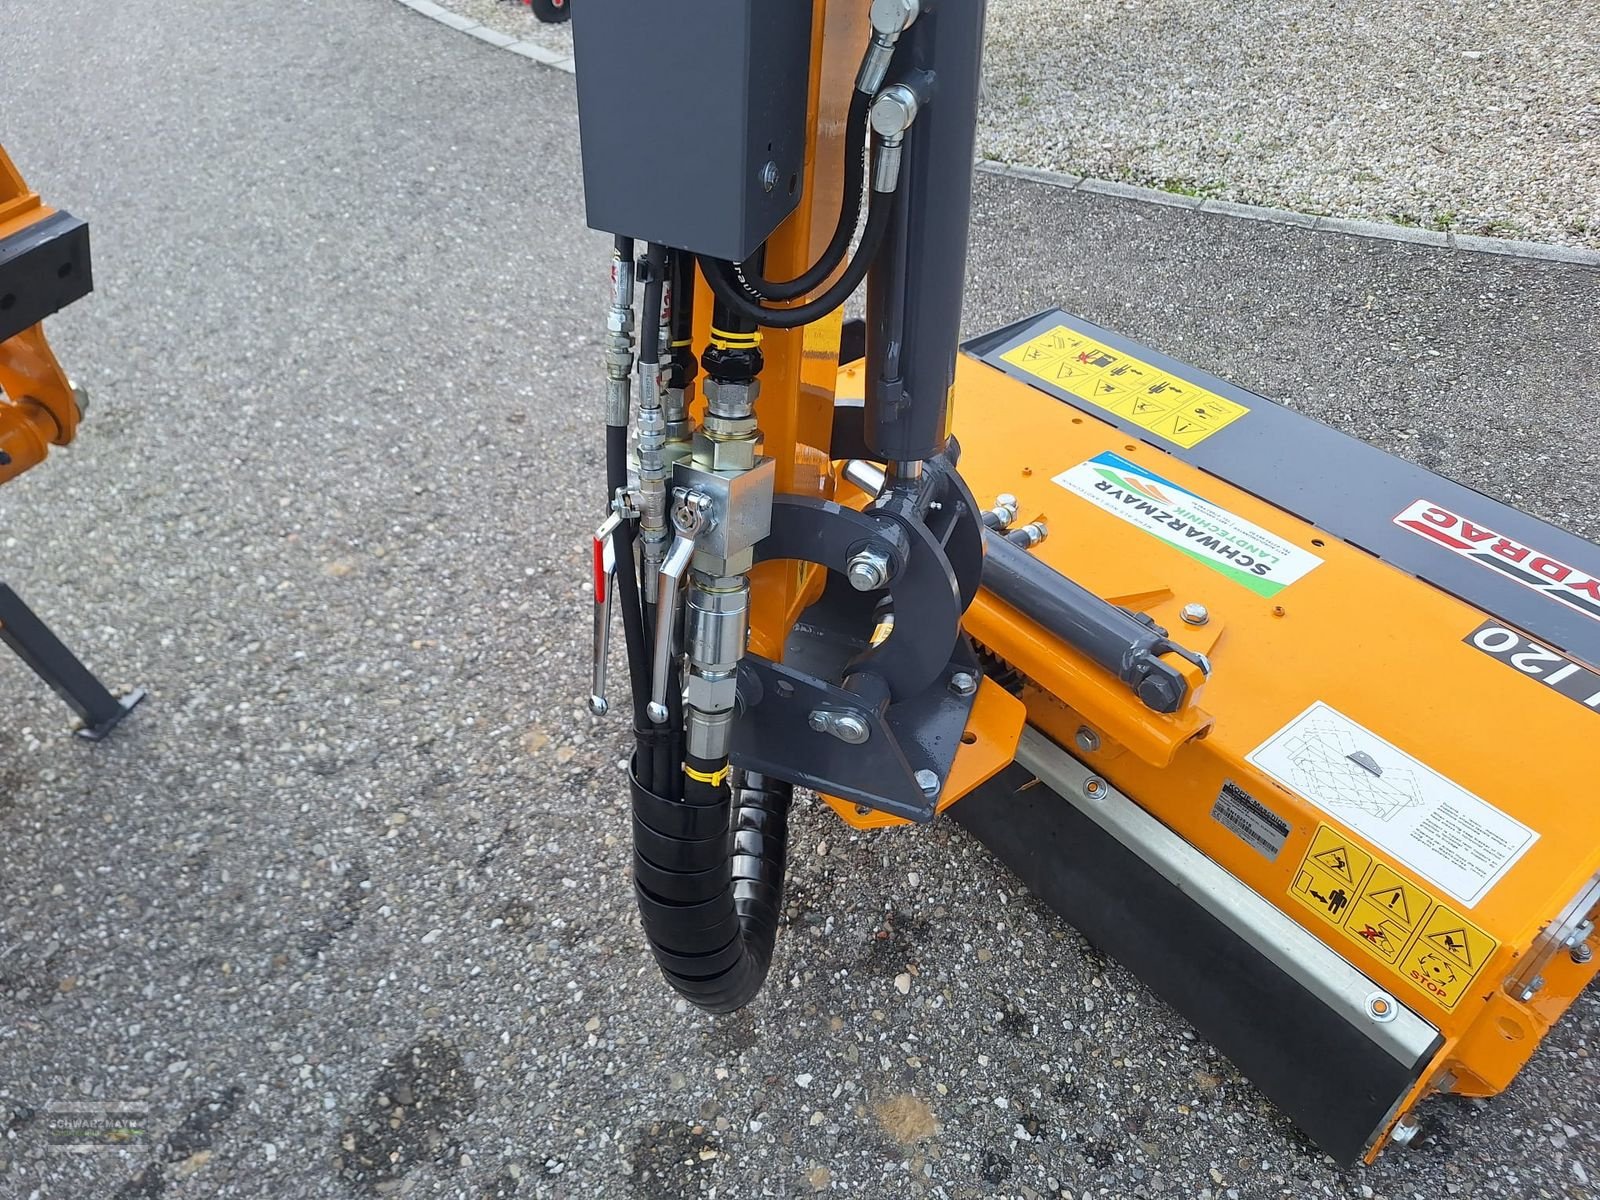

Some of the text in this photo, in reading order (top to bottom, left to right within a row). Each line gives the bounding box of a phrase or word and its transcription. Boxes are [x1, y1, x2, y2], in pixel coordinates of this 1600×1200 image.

[1094, 480, 1272, 577] SCHWARZMAYR
[1172, 507, 1280, 565] LANDTECHNIK
[1473, 627, 1580, 686] 120
[1410, 969, 1448, 999] STOP
